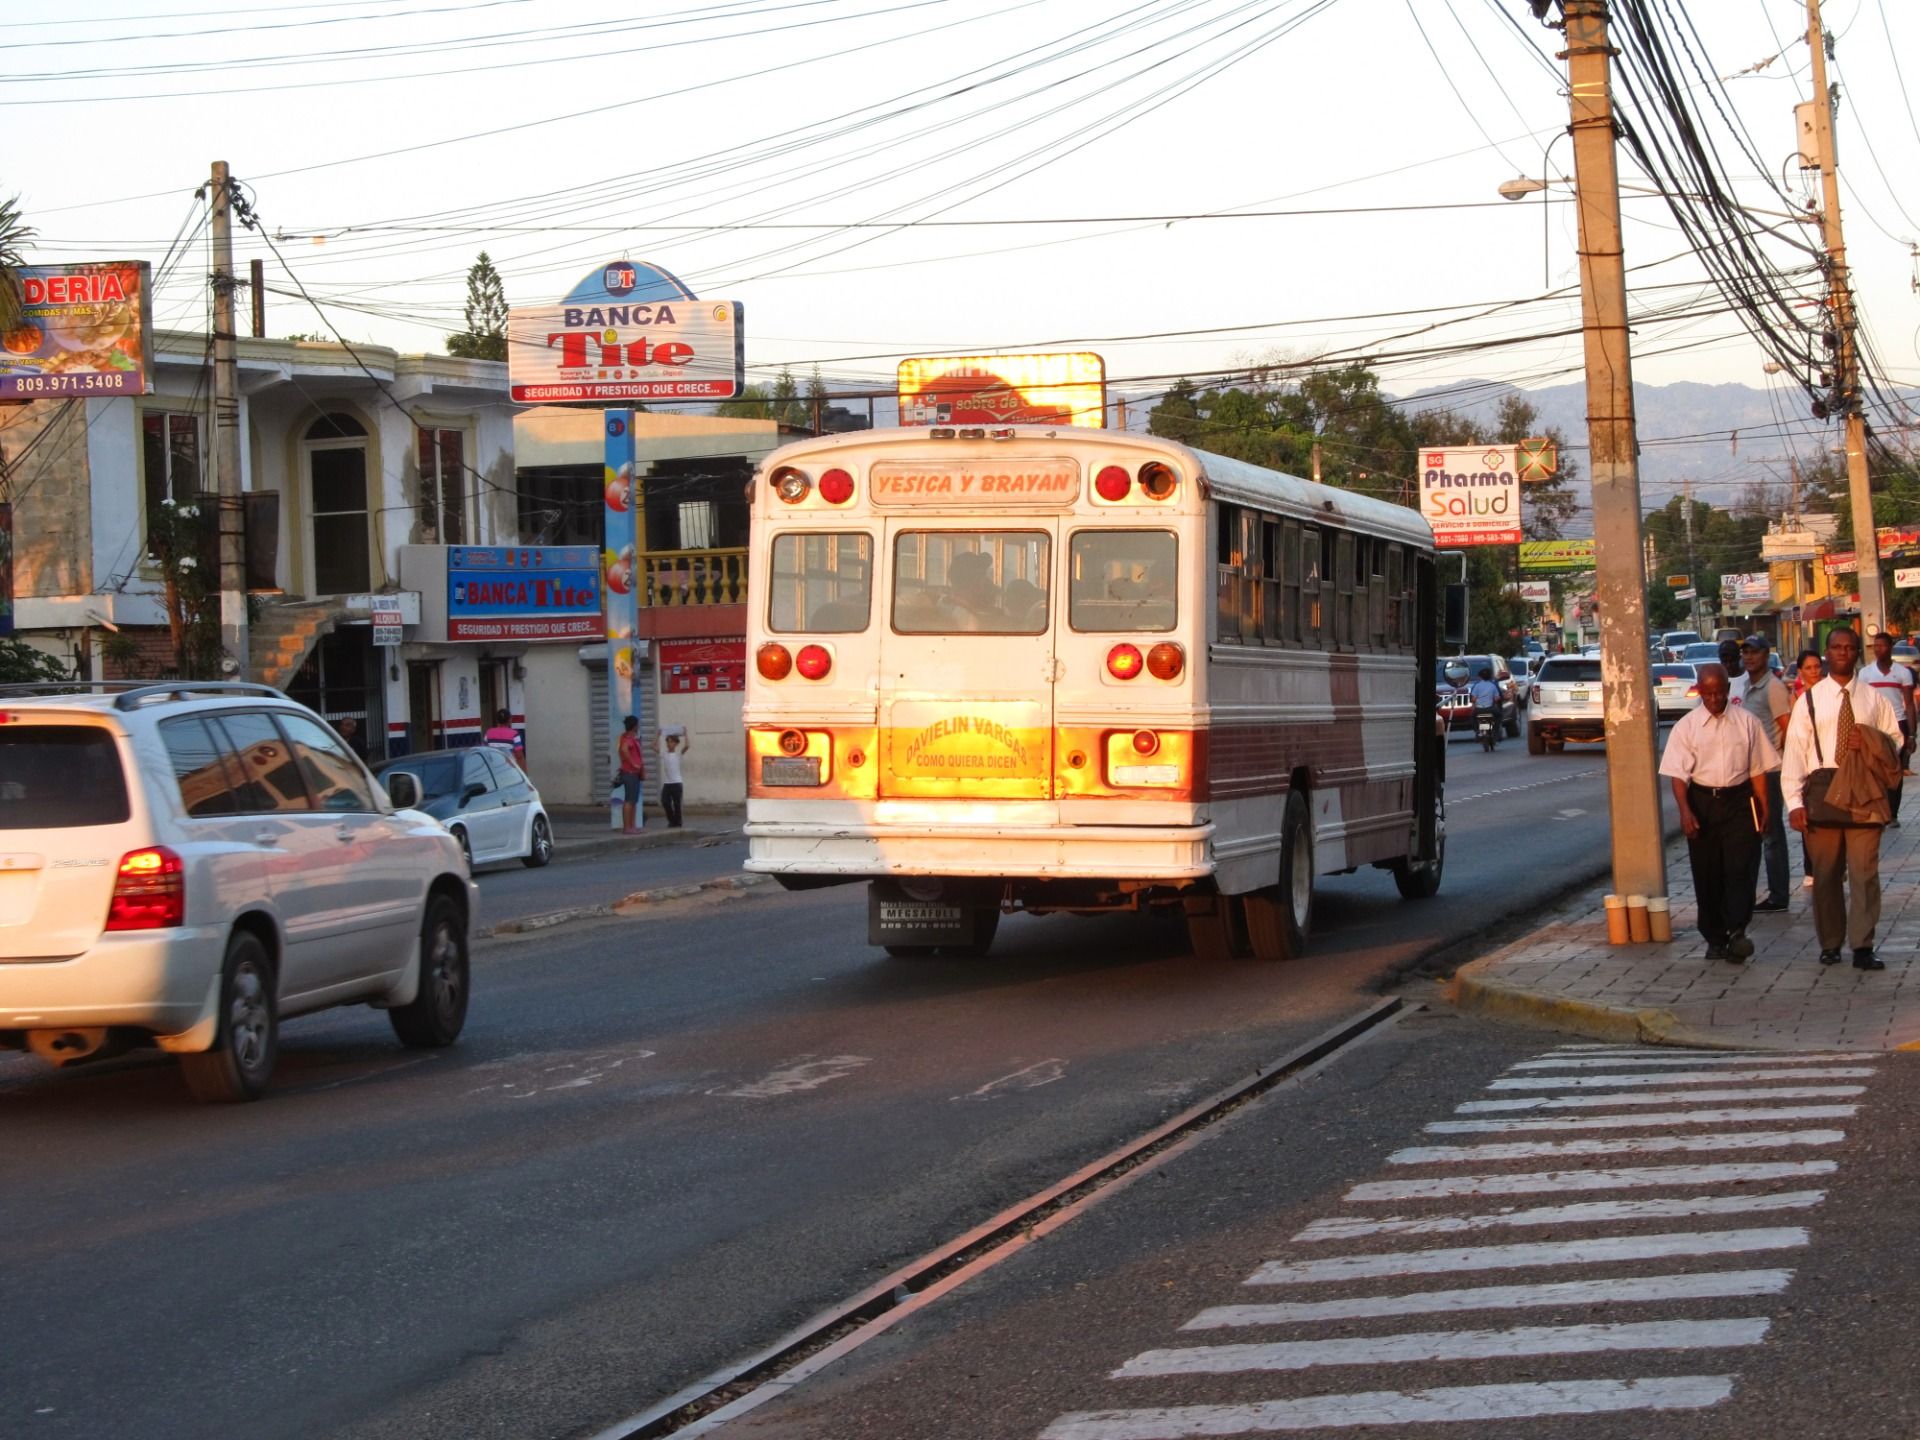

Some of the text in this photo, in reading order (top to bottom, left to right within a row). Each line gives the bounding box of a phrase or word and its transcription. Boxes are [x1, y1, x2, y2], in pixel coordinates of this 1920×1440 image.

[606, 269, 635, 288] BT
[23, 273, 126, 305] DERIA
[63, 308, 69, 316] Y
[564, 305, 676, 327] BANCA
[547, 329, 695, 368] Tite
[16, 374, 123, 392] 809.971.5408
[524, 382, 720, 398] SEGURIDAD Y PRESTIGIO QUE CRECE...
[956, 396, 996, 410] sobre
[1428, 456, 1443, 464] SG
[878, 474, 1070, 493] YESICA Y BRAYAN
[1425, 469, 1514, 488] Pharma
[1430, 489, 1508, 517] Salud
[1432, 521, 1465, 529] SERVICIO
[467, 582, 528, 605] BANCA
[528, 578, 594, 607] Tite
[457, 624, 502, 635] SEGURIDAD
[503, 624, 510, 633] Y
[510, 623, 550, 634] PRESTIGIO
[551, 623, 566, 633] QUE
[661, 638, 712, 646] COMPRA
[906, 716, 1027, 766] DAVIELIN VARGAS
[916, 755, 1017, 768] COMO QUIERA DICEN
